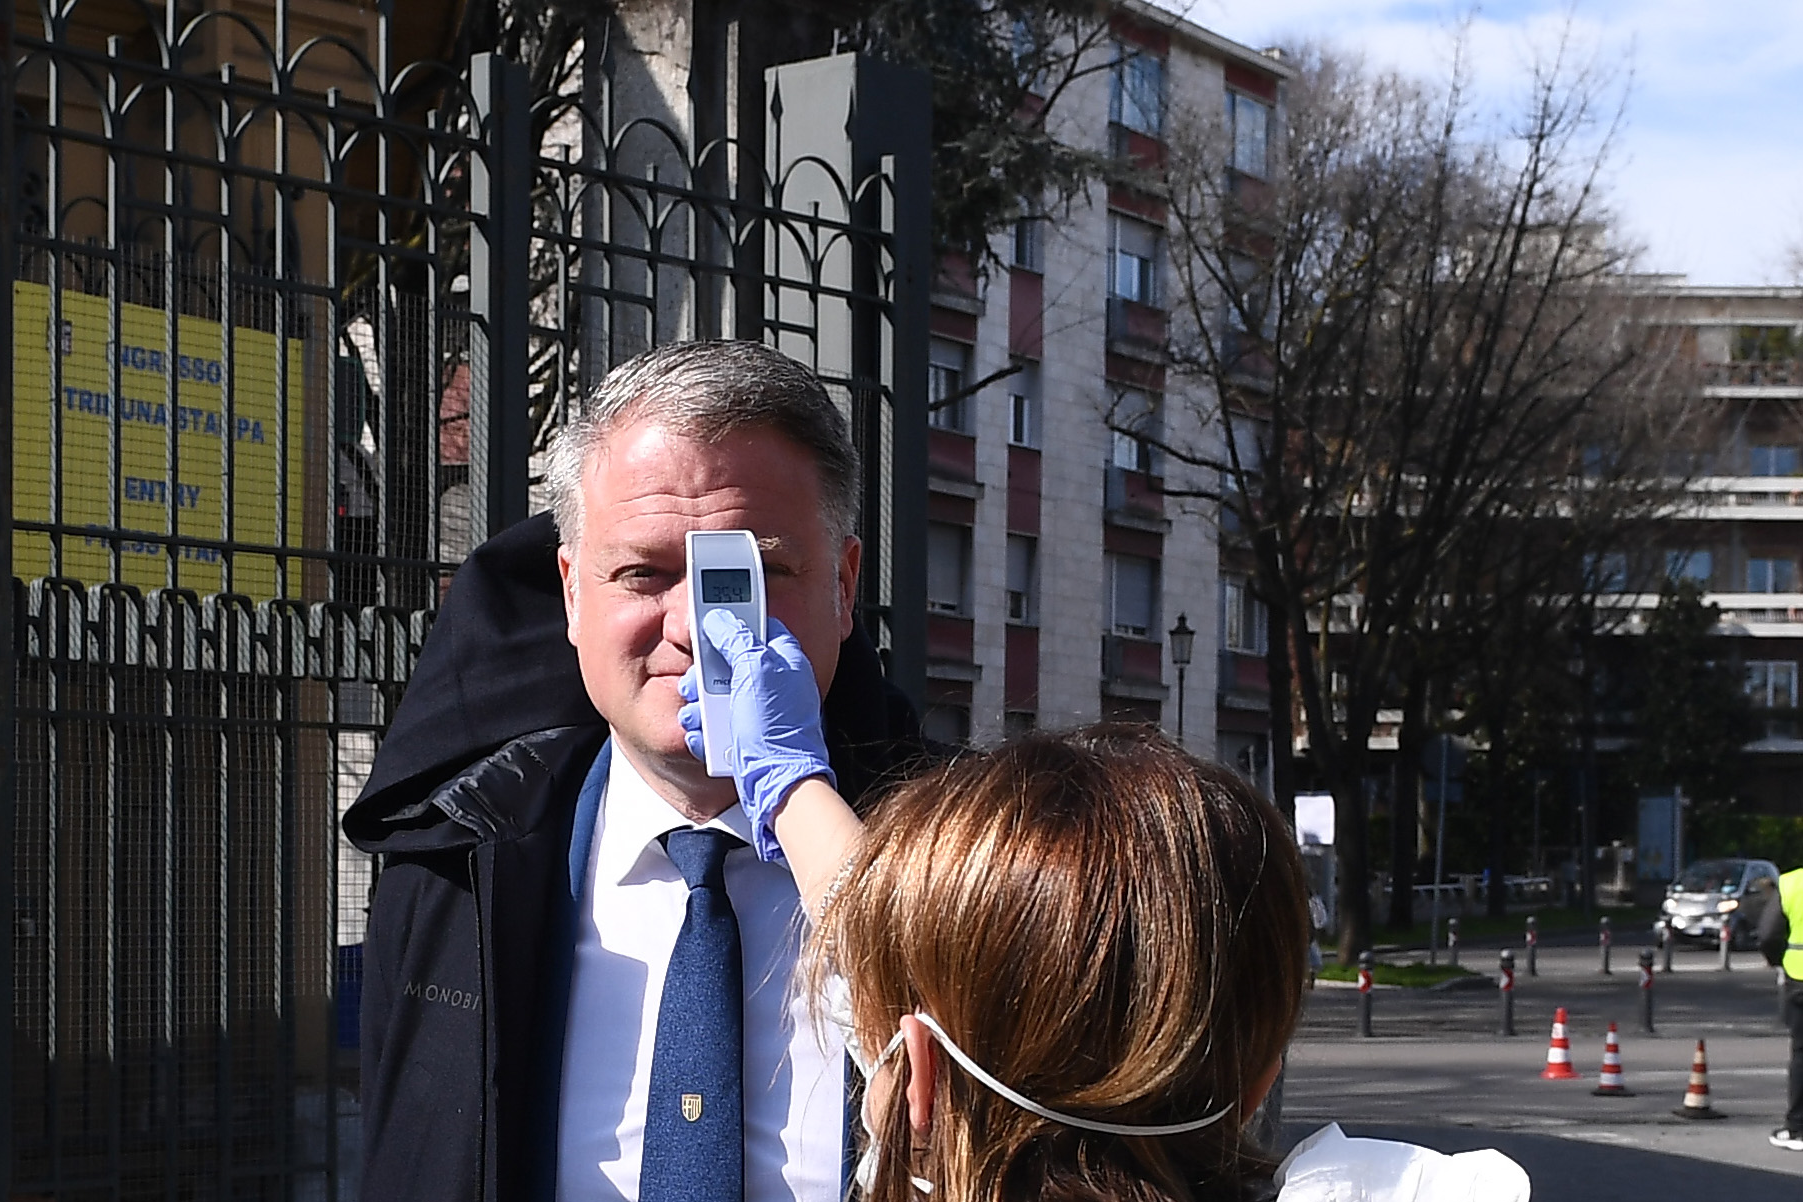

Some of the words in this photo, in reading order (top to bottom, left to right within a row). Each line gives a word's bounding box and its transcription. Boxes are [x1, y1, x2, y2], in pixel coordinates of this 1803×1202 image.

[106, 343, 222, 384] NGRSSO
[176, 406, 265, 444] STAPA
[403, 981, 479, 1010] MONOBI
